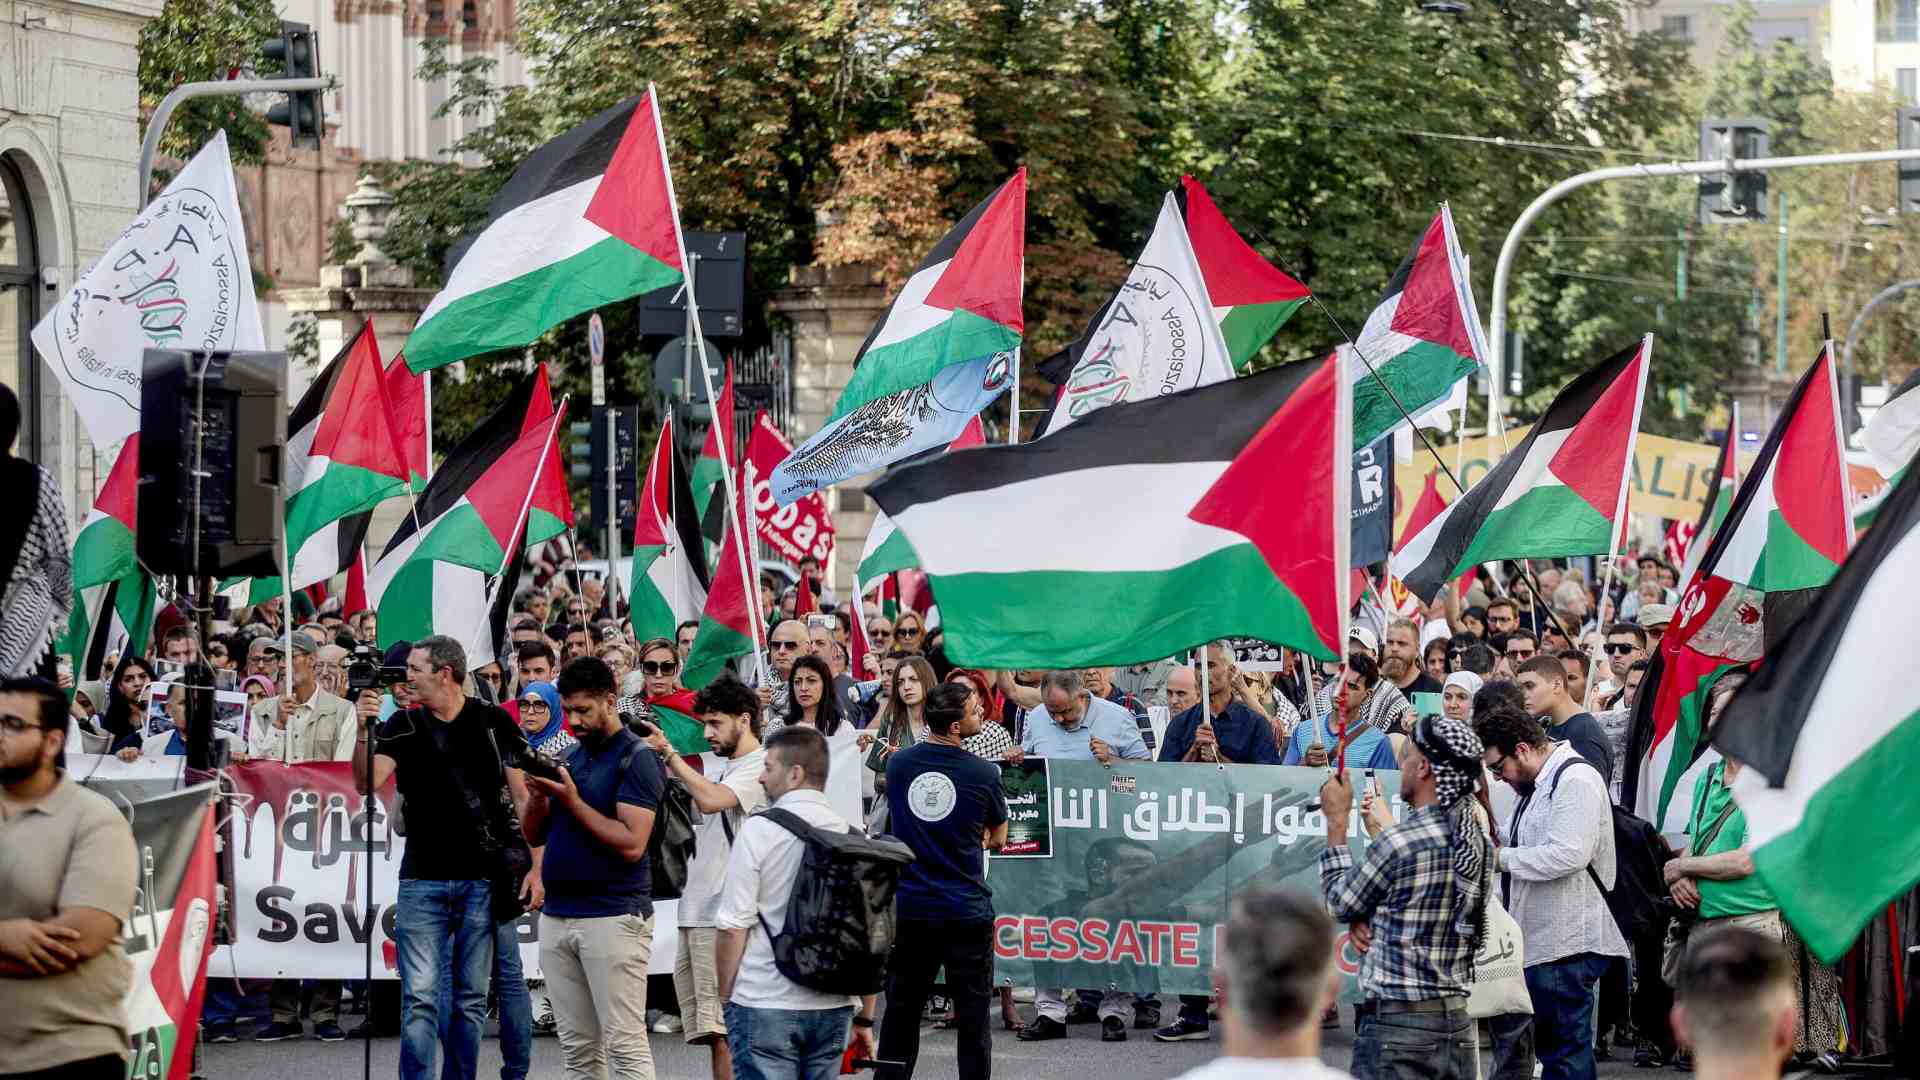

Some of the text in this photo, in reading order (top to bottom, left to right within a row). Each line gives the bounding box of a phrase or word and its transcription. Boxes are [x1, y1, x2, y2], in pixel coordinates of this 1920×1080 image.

[752, 468, 831, 561] obas
[1054, 786, 1108, 830] النا
[1123, 786, 1246, 844] إطلاق
[993, 917, 1200, 968] CESSATE
